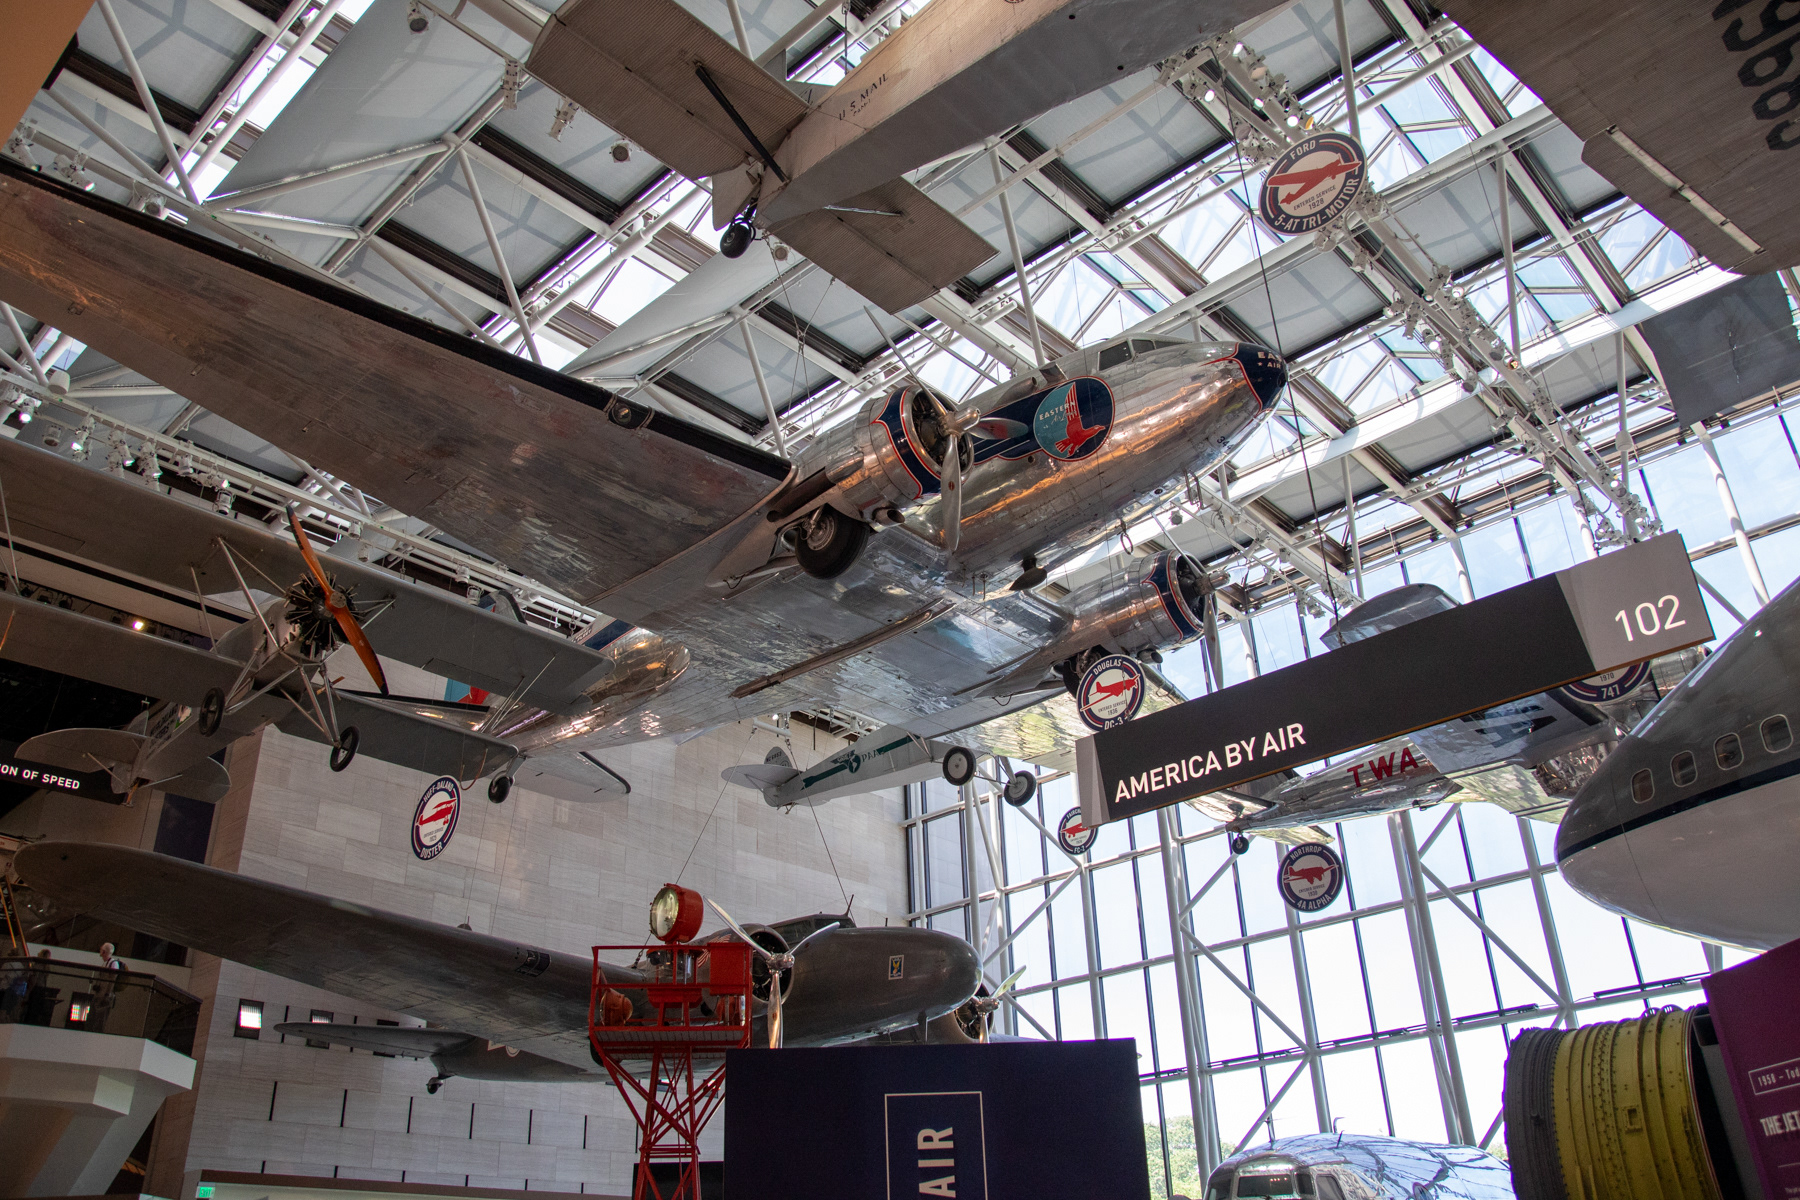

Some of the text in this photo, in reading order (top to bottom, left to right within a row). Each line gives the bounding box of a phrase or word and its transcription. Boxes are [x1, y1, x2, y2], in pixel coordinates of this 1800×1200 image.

[861, 73, 888, 102] MAIL
[1290, 140, 1316, 160] FORD
[1274, 178, 1360, 231] 5-AT TRI-MOTOR
[1293, 185, 1337, 211] ENTERED SERVICE
[1308, 197, 1325, 211] 1928
[1039, 401, 1076, 421] EASTERN
[1615, 594, 1687, 642] 102
[1093, 658, 1122, 675] DOUGLAS
[1601, 683, 1620, 699] 747
[1104, 716, 1124, 730] DC-3
[1114, 722, 1307, 803] AMERICA BY AIR
[1346, 747, 1419, 788] TWA
[0, 763, 81, 790] ON OF SPEED
[420, 841, 443, 859] DUSTER
[1289, 845, 1323, 860] NORTHROP
[1297, 893, 1332, 910] 4A ALPHA
[1760, 1110, 1800, 1137] THE JET
[917, 1126, 957, 1198] AIR
